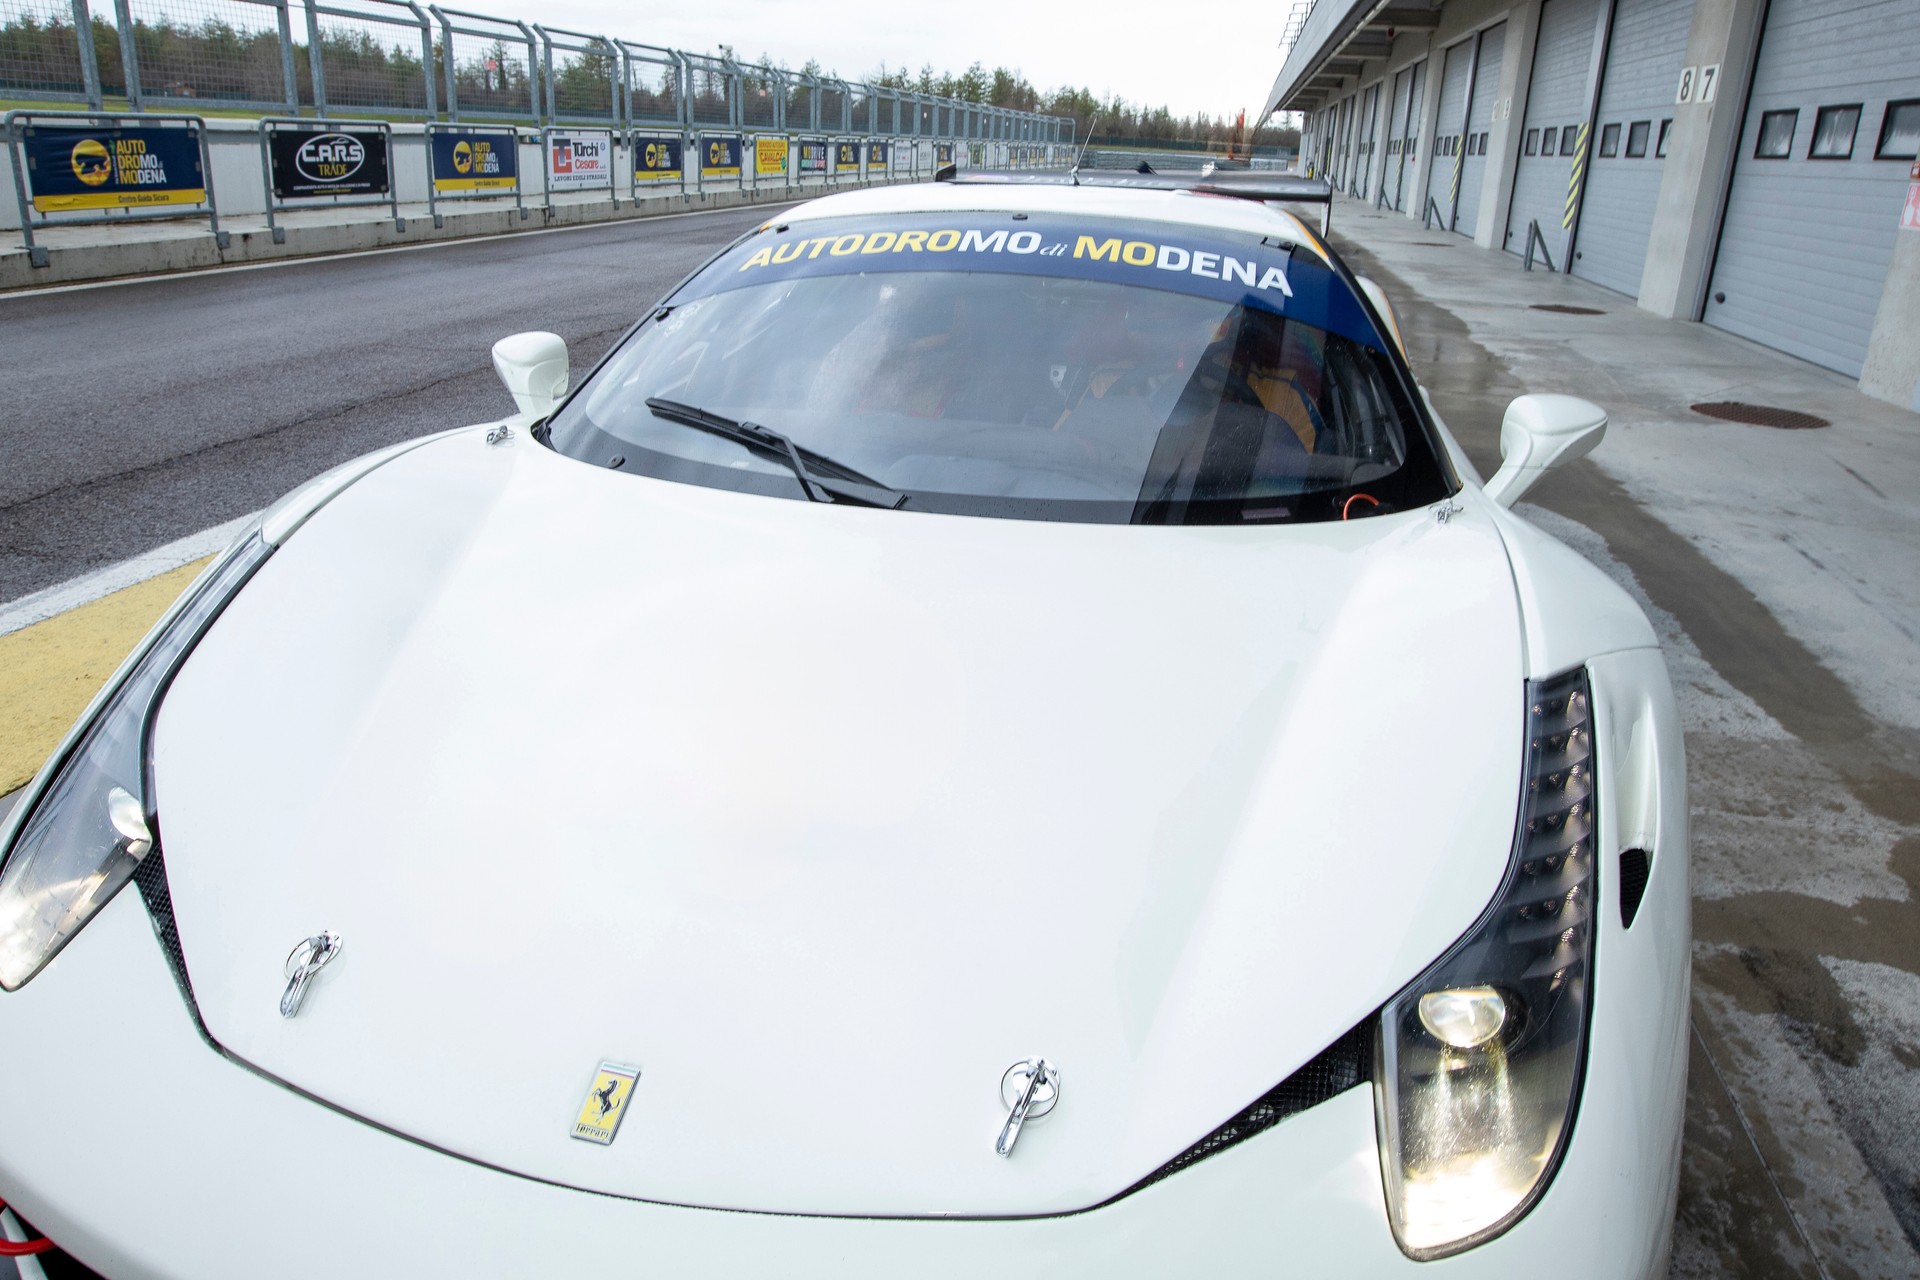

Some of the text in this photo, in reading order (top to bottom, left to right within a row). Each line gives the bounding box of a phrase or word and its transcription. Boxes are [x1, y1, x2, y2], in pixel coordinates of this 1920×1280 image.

[1680, 67, 1716, 101] 8 7
[116, 139, 146, 155] AUTO
[474, 142, 490, 152] AUTO
[572, 142, 599, 157] Turchi
[117, 154, 158, 170] DROMO
[318, 163, 348, 176] TRADE
[475, 162, 499, 173] MODENA
[575, 158, 599, 170] Cesare
[119, 169, 167, 184] MODENA
[738, 229, 1293, 298] AUTODROMO di MODENA
